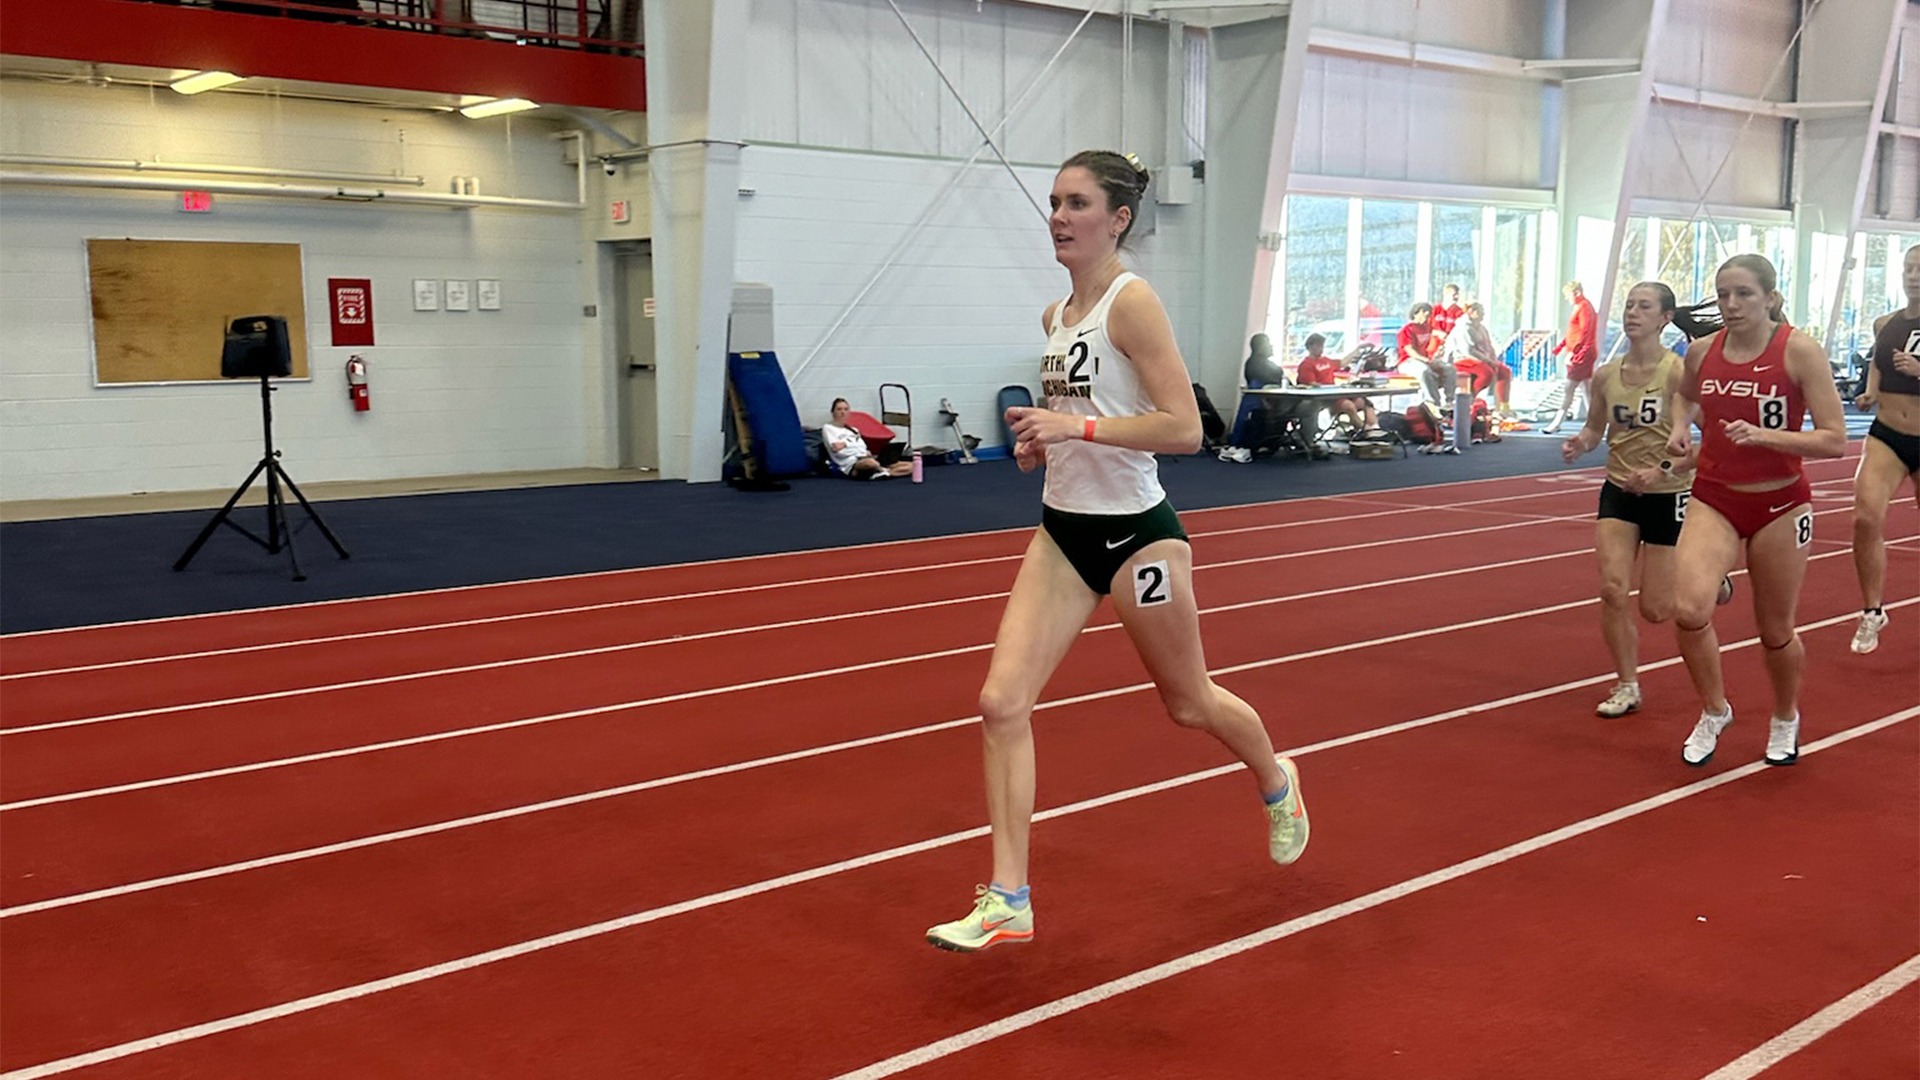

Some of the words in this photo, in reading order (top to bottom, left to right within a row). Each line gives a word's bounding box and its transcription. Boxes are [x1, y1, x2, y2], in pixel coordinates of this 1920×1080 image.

[1068, 341, 1090, 383] 2
[1700, 379, 1777, 399] SVSU
[1640, 399, 1657, 424] 5
[1763, 400, 1783, 429] 8
[1799, 515, 1810, 544] 8
[1137, 566, 1166, 604] 2
